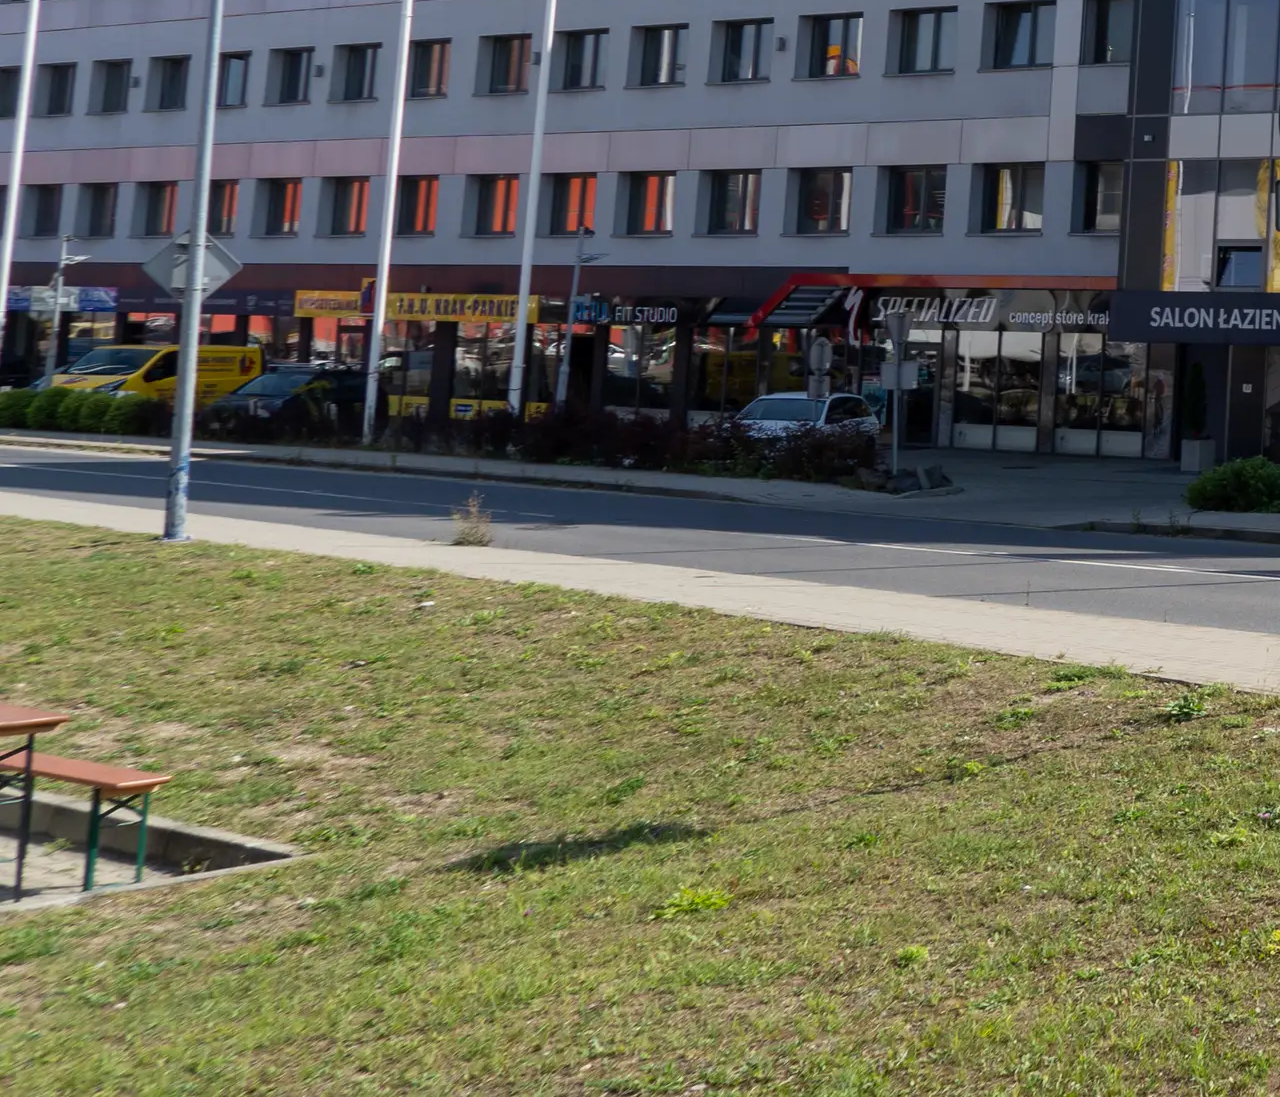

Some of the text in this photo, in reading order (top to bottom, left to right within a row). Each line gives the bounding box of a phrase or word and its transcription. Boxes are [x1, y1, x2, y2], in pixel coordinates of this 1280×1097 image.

[435, 299, 521, 316] KRAK-PARKIE
[615, 306, 633, 322] FIT
[635, 307, 678, 323] STUDIO
[872, 297, 998, 323] SPECIALIZED
[1009, 310, 1053, 326] concept
[1055, 311, 1084, 325] store
[1149, 307, 1215, 329] SALON
